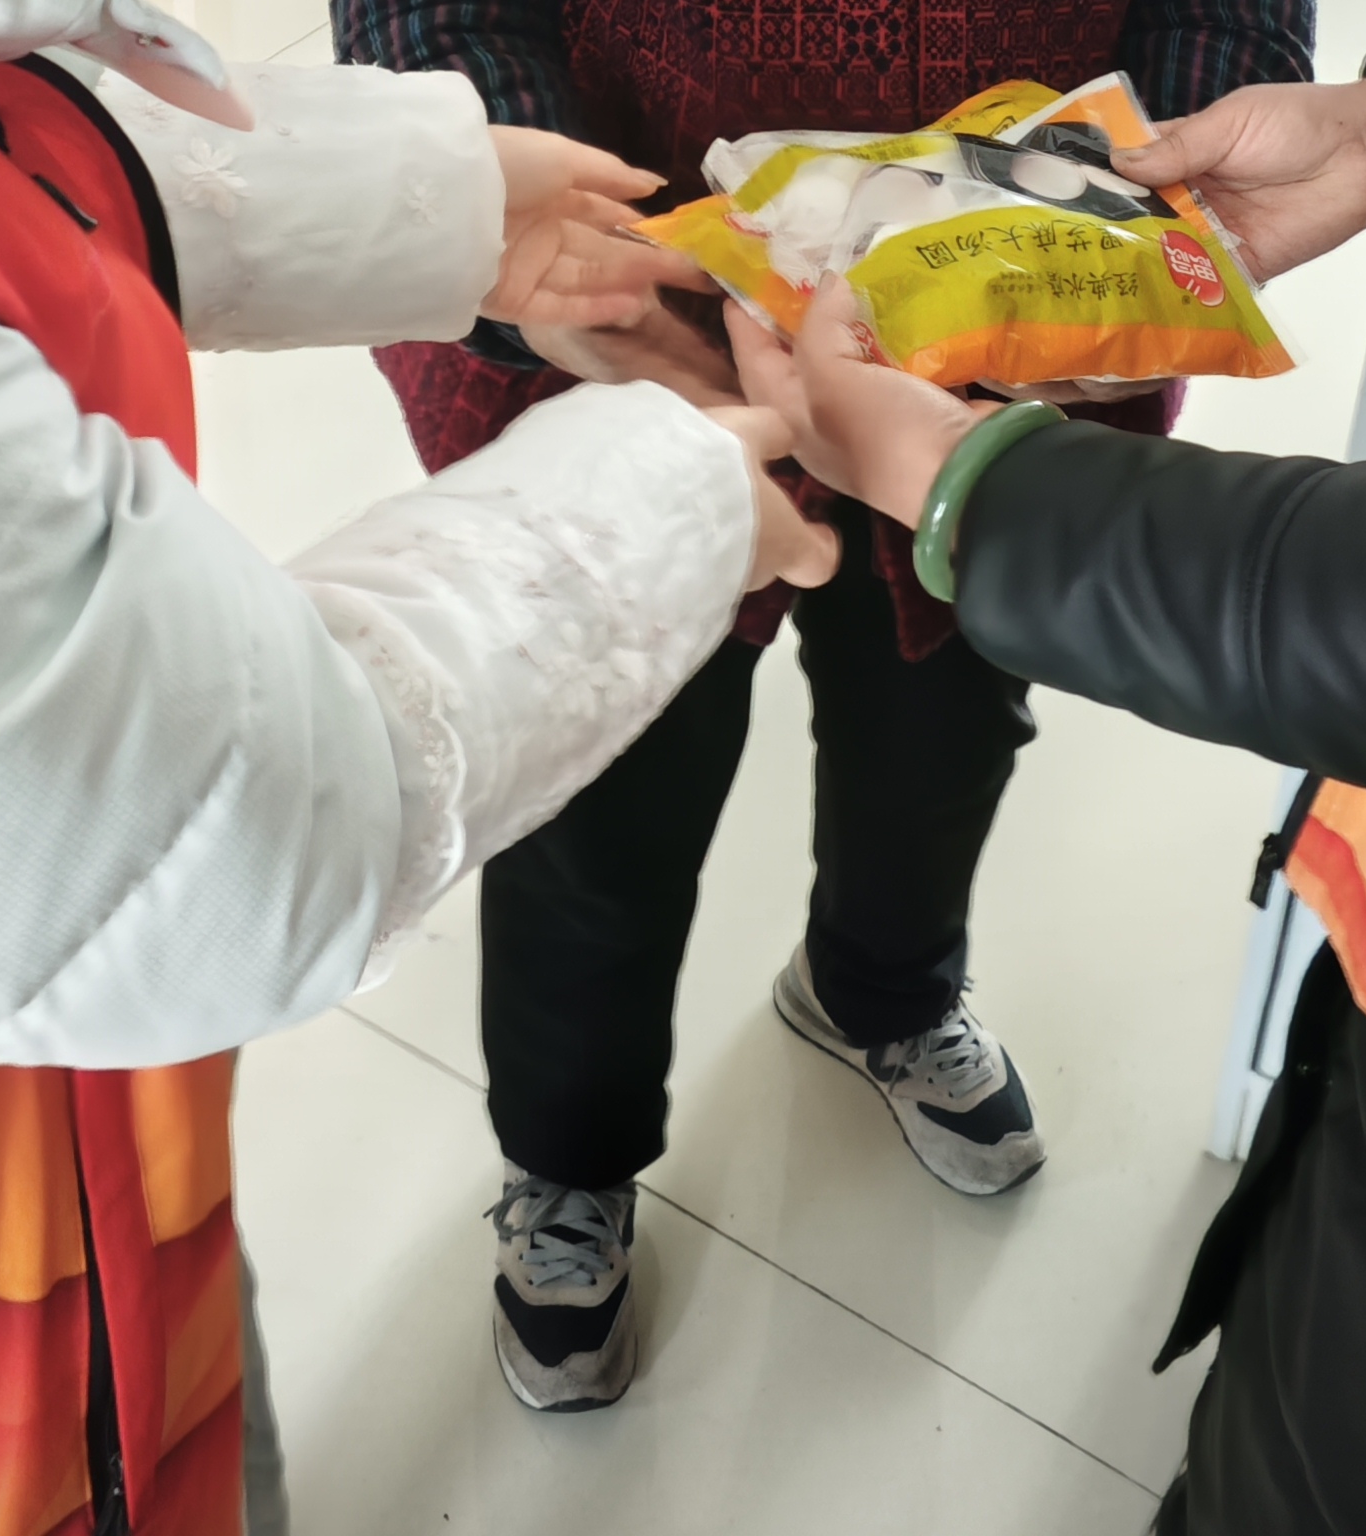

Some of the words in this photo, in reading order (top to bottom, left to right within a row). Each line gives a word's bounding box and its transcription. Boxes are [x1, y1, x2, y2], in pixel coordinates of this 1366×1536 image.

[916, 219, 1123, 268] 黑芝麻大汤圆
[1045, 271, 1138, 301] 经典水磨
